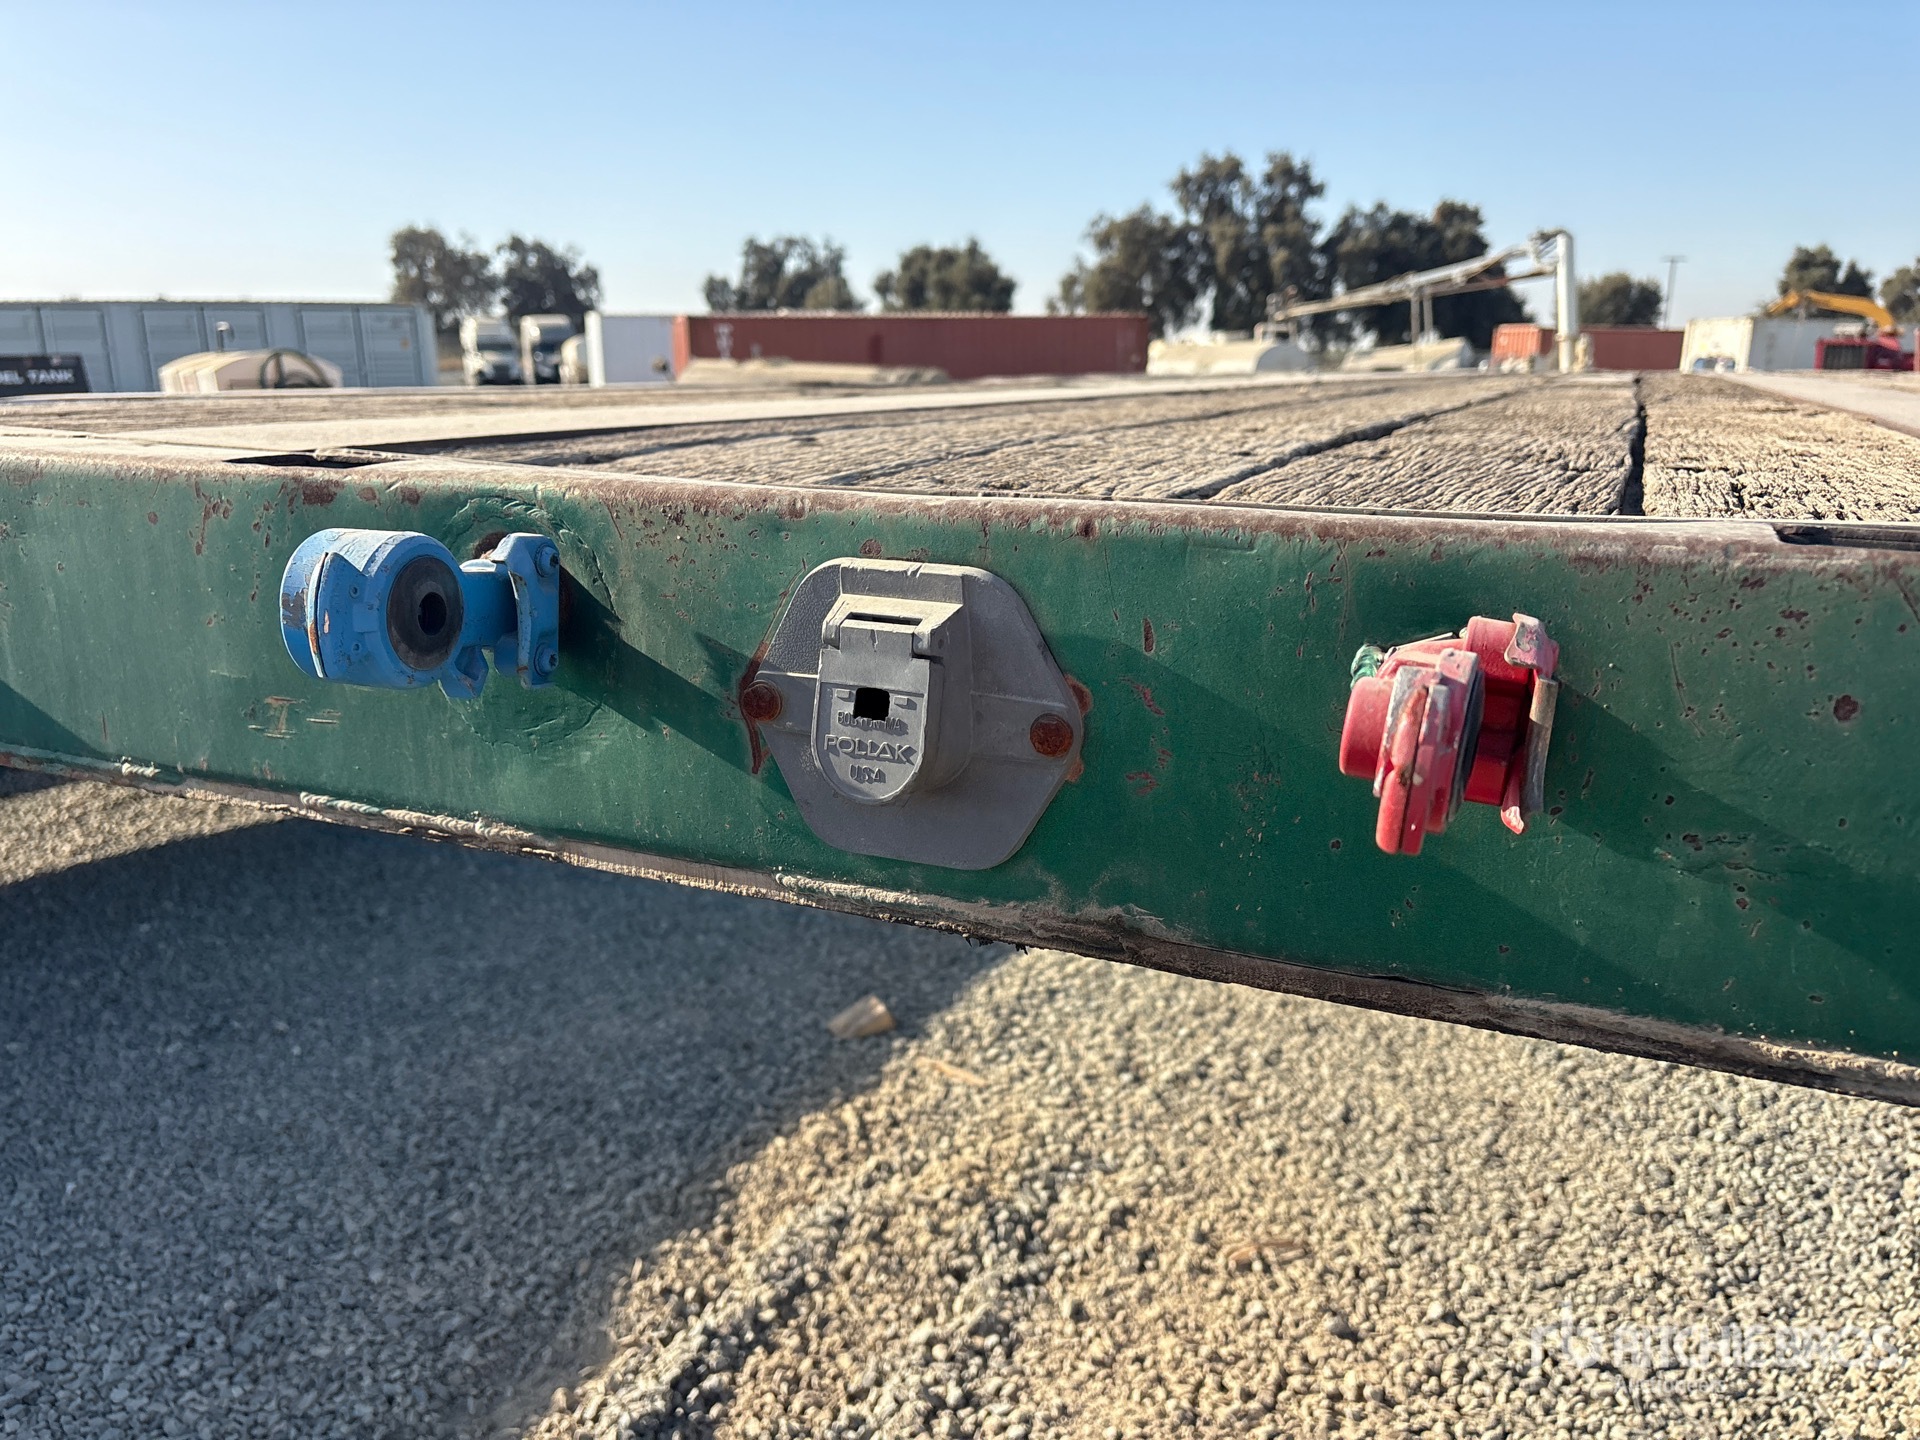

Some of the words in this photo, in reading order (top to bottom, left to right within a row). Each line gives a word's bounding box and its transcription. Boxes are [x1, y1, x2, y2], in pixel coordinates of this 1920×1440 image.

[28, 369, 75, 384] TANK
[824, 734, 914, 764] POLLAK
[849, 764, 885, 783] USA
